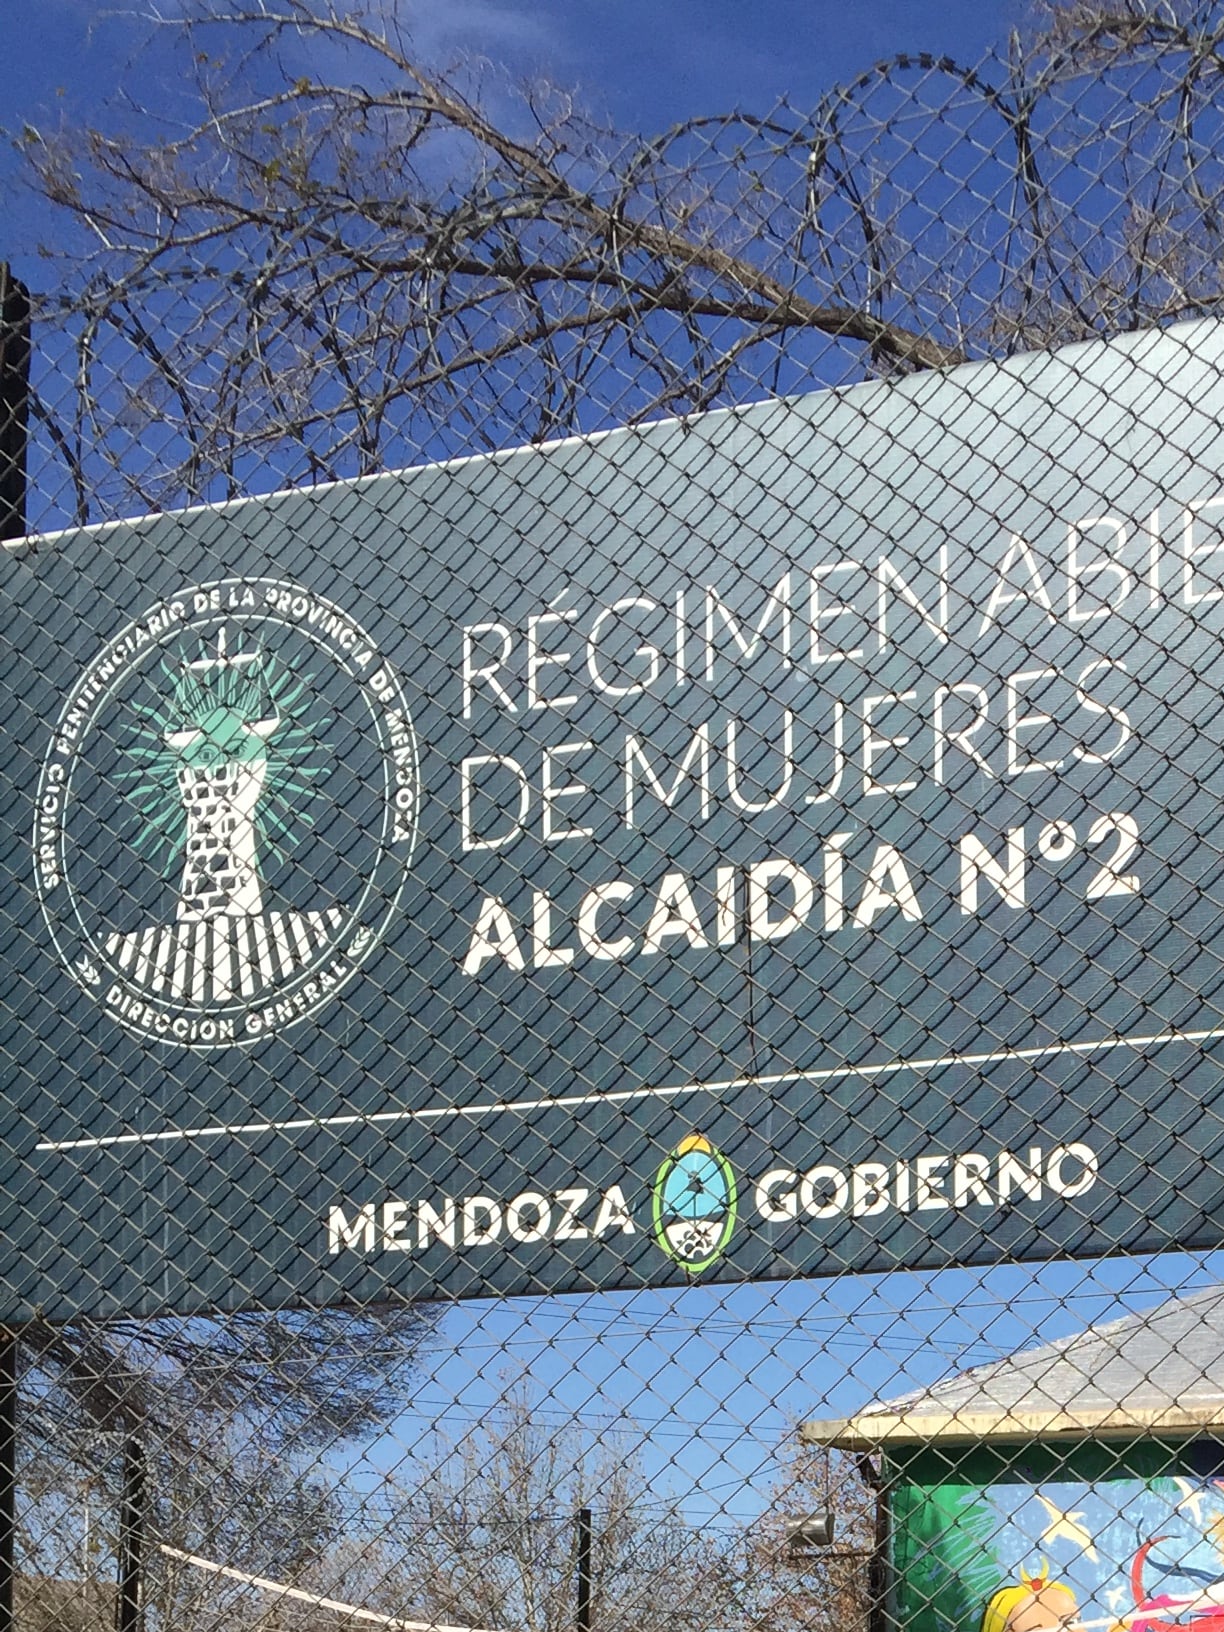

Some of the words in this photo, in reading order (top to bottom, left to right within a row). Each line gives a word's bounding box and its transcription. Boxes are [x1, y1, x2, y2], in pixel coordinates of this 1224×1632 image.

[462, 544, 948, 719] RÉGIMEN
[39, 763, 65, 890] SERVICIO
[56, 601, 186, 755] PENITENCIARIO
[194, 588, 220, 614] DE
[228, 587, 255, 607] LA
[263, 587, 373, 672] PROVINCIA
[369, 669, 395, 703] DE
[384, 708, 414, 844] MENDOZA
[462, 741, 594, 852] DE
[625, 660, 1131, 830] MUJERES
[462, 832, 924, 976] ALCAIDÍA
[245, 960, 347, 1033] GENERAL
[329, 1185, 637, 1255] MENDOZA
[755, 1142, 1100, 1223] GOBIERNO
